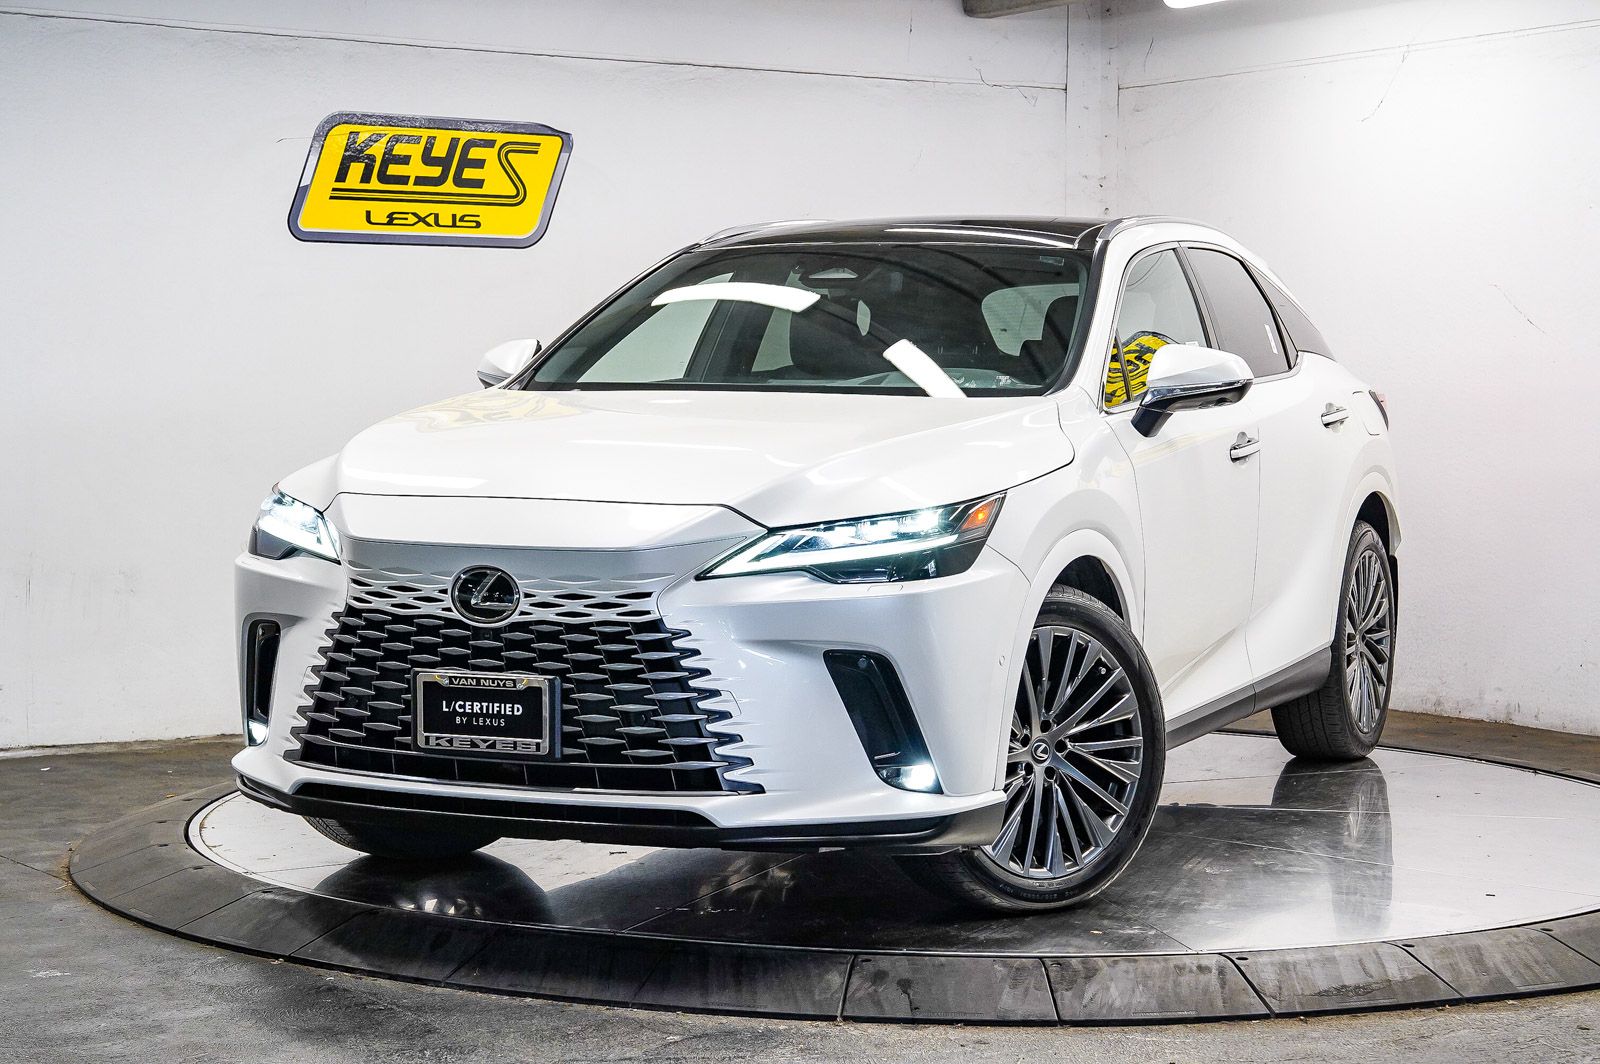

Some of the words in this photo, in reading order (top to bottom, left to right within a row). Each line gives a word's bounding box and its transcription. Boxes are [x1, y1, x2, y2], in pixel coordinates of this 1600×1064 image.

[329, 131, 541, 207] KEYES
[365, 209, 482, 229] LEXUS
[451, 677, 476, 686] VAN
[480, 678, 514, 688] NUYS
[442, 700, 523, 715] L/CERTIFIED
[455, 716, 467, 724] BY
[472, 717, 505, 727] LEXUS
[429, 736, 537, 752] KEYES
